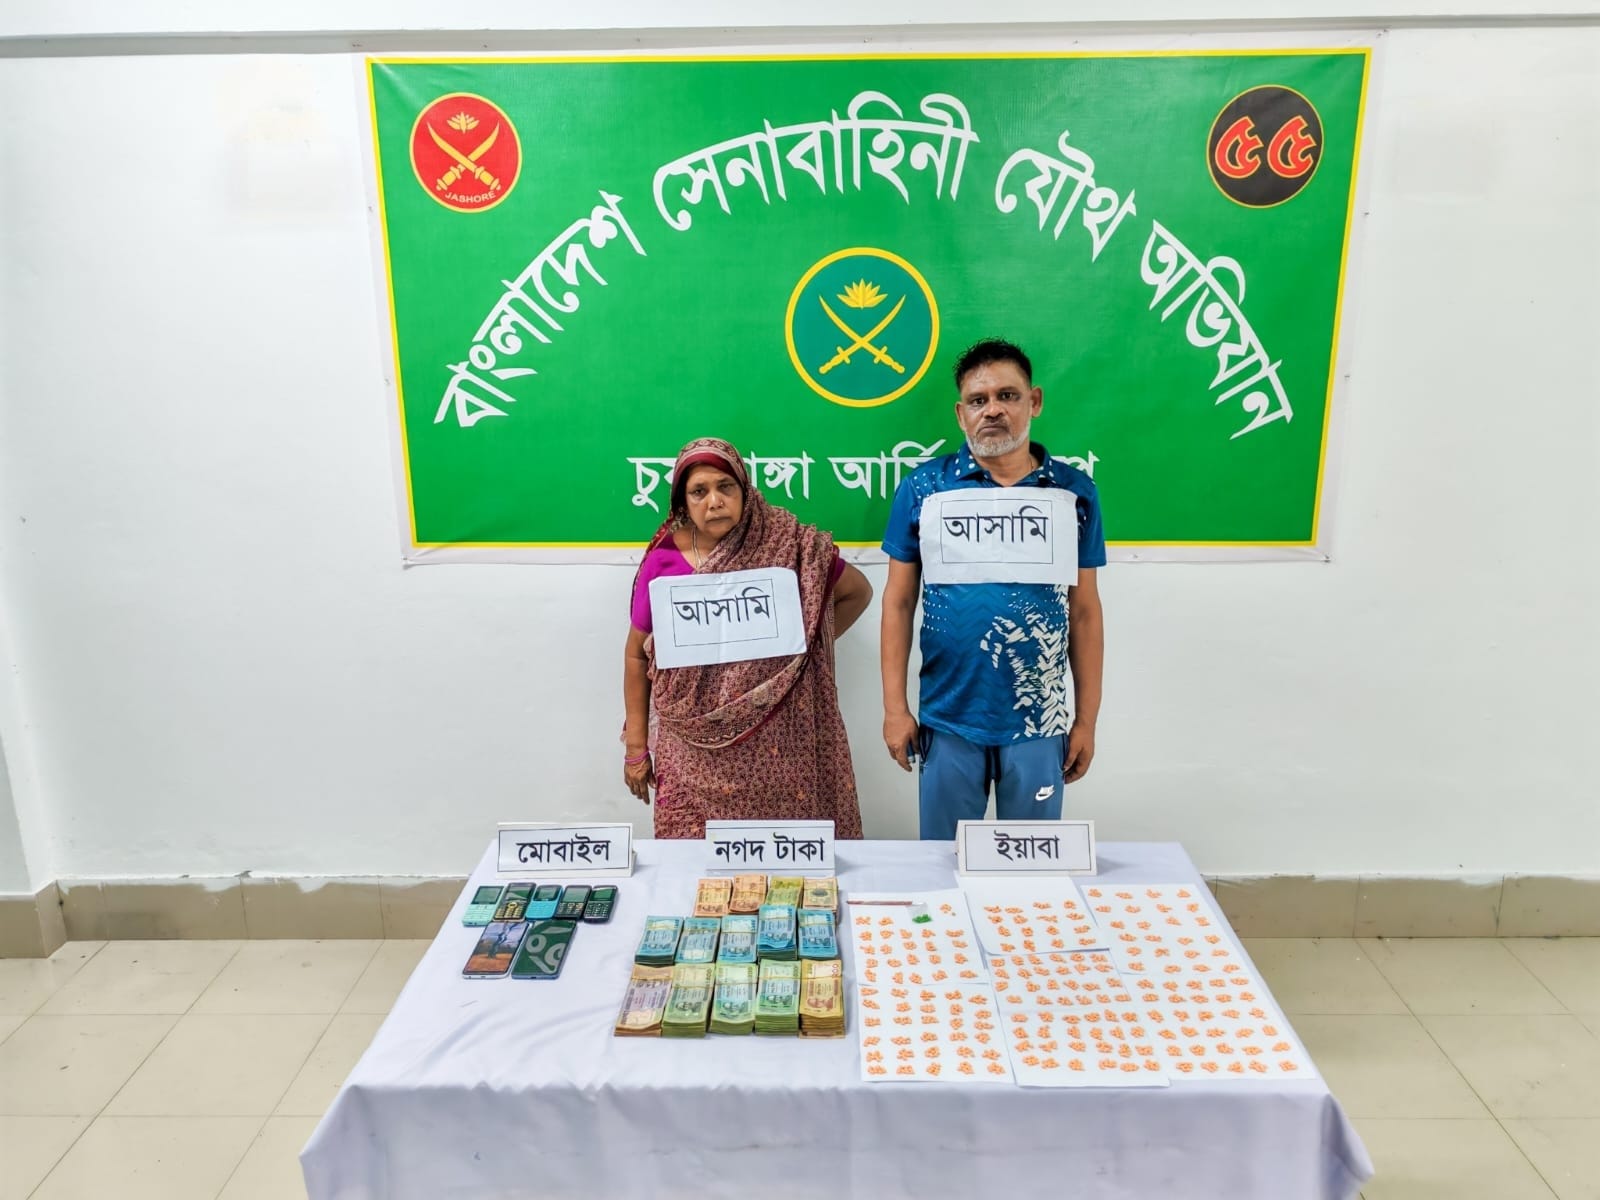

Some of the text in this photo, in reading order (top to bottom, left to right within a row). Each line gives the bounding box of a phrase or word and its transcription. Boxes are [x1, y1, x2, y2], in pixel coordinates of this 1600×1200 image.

[1215, 115, 1317, 179] ৫৫
[445, 189, 497, 203] JASHORE
[434, 90, 1293, 439] বাংলাদেশ সেনাবাহিনী যৌথ অভিযান
[943, 504, 1050, 544] আসামি
[673, 586, 771, 626] আসামি
[516, 834, 611, 864] মোবাইল
[714, 832, 825, 863] নগদ টাকা
[994, 829, 1060, 861] ইয়াবা
